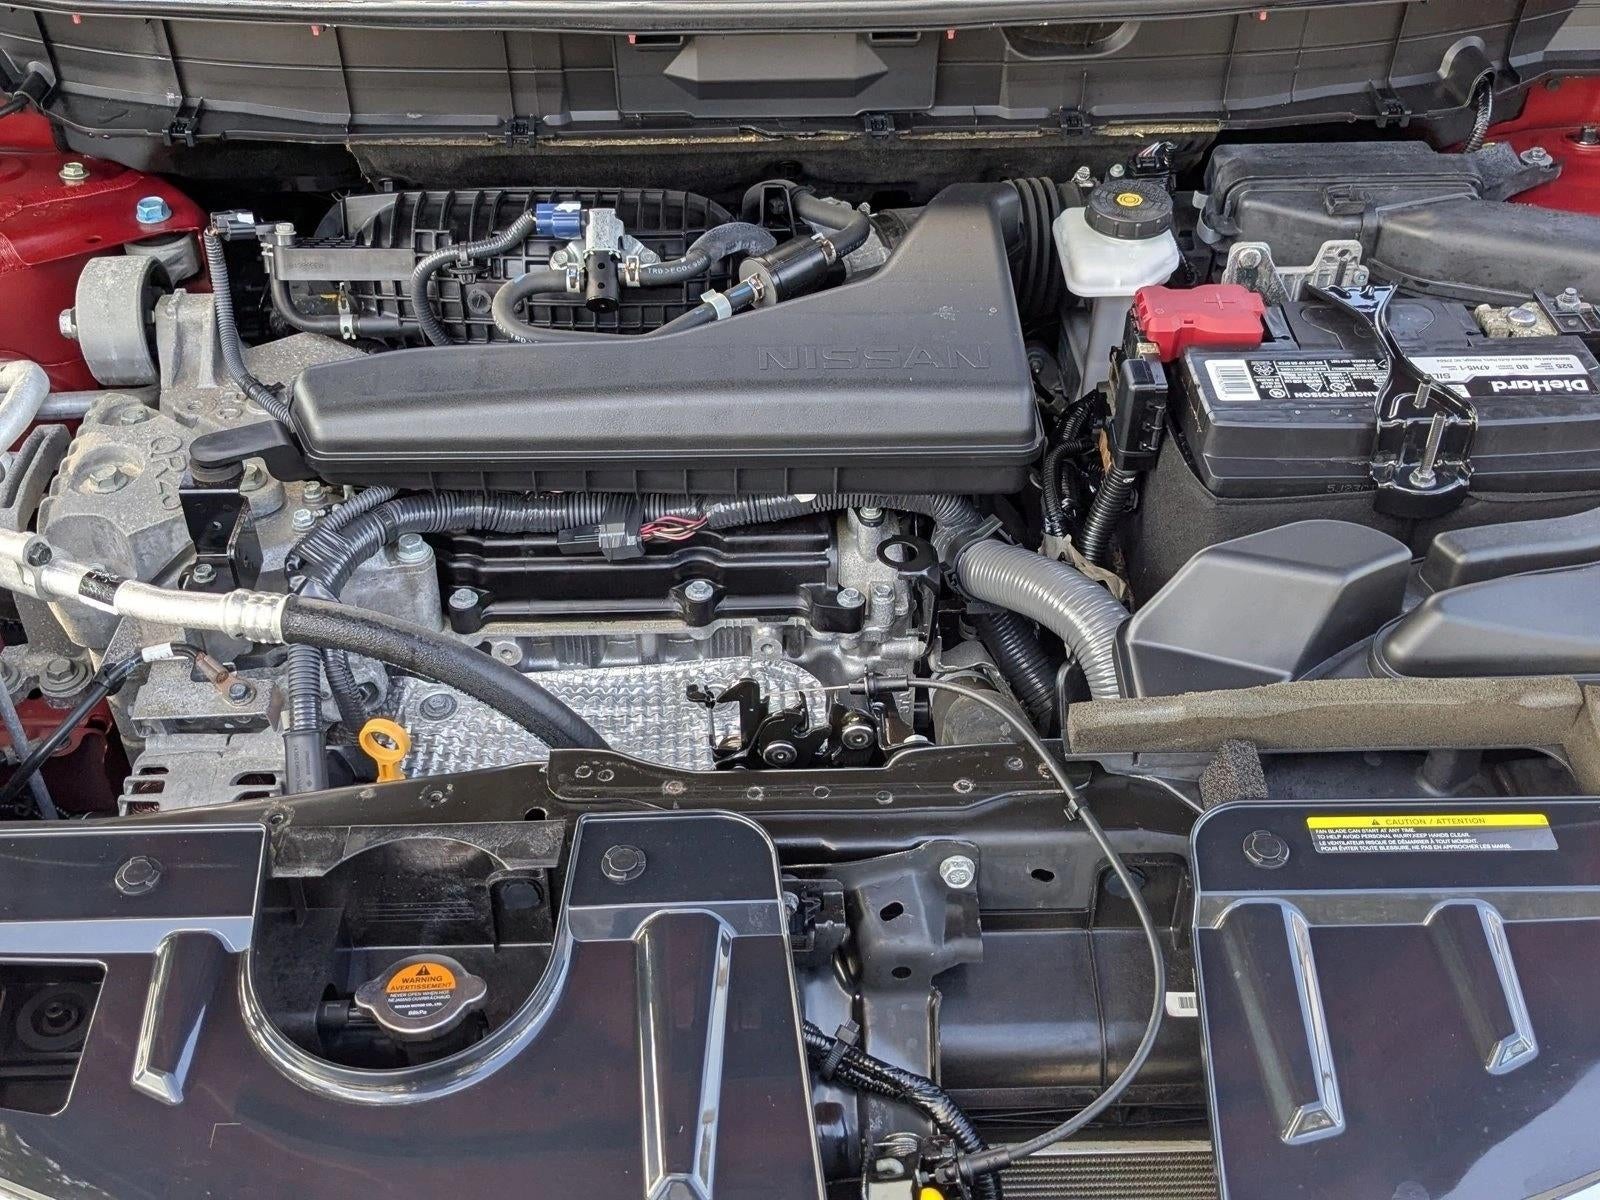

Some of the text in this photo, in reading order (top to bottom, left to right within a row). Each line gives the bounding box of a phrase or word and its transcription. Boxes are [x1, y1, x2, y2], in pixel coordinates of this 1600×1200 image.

[757, 344, 991, 369] NISSAN
[1490, 379, 1589, 392] DieHard
[1385, 818, 1426, 826] CAUTION
[1436, 817, 1486, 825] ATTENTION
[391, 983, 452, 991] AVERTISSEMENT
